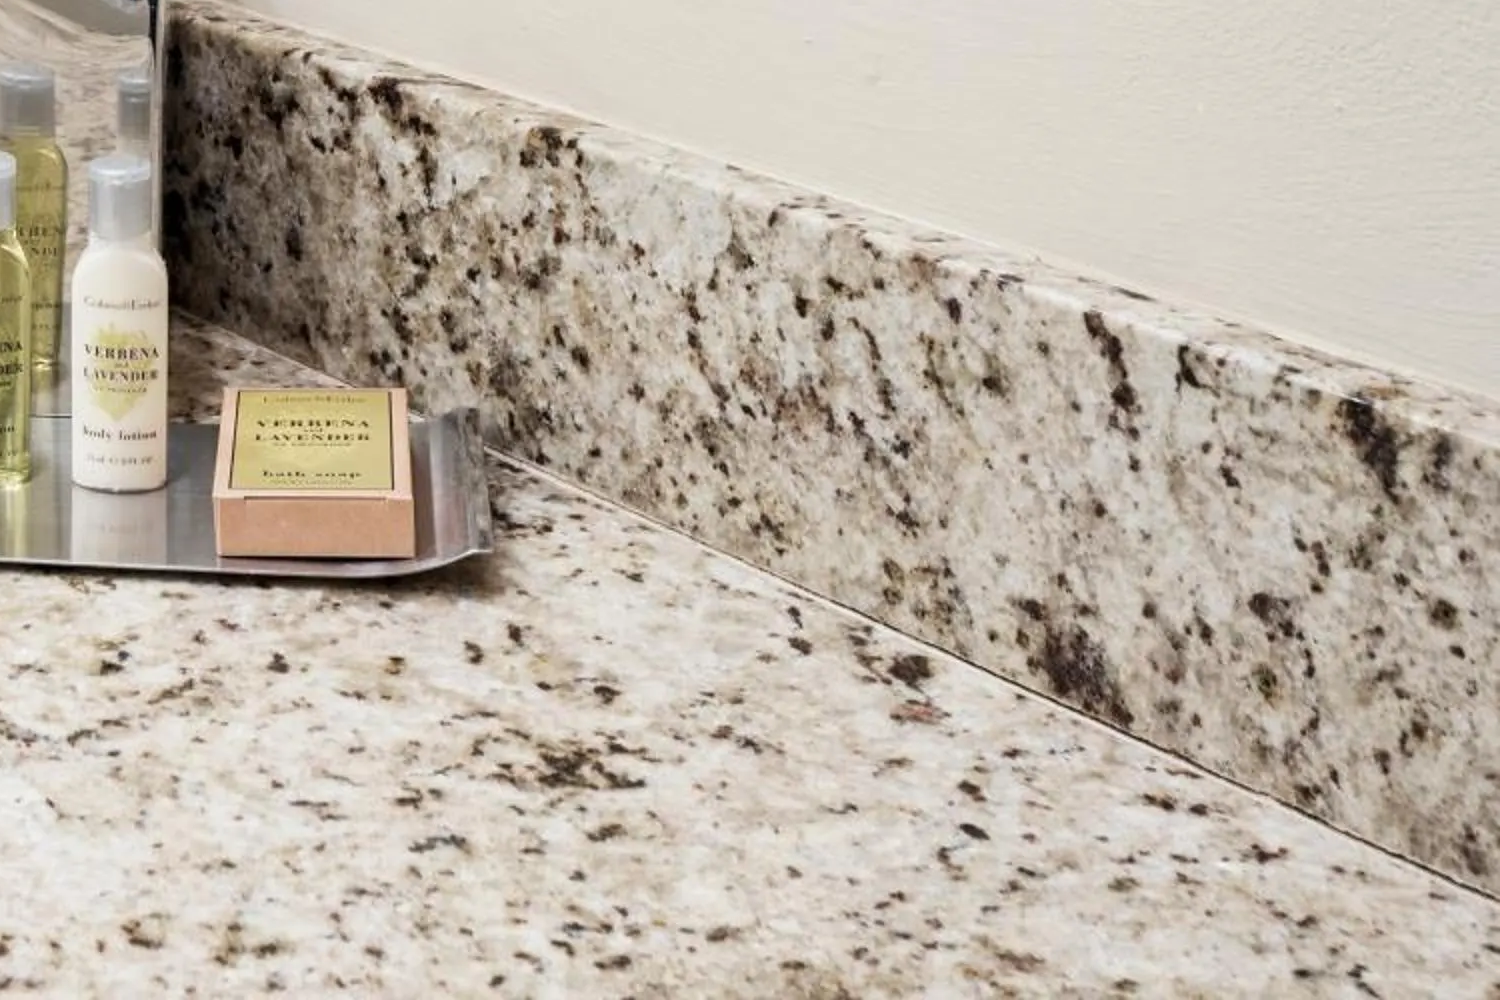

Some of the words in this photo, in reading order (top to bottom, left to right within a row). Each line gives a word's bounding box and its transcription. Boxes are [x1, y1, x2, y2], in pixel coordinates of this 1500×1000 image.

[83, 344, 160, 360] VERBENA
[83, 366, 159, 382] LAVENDER
[256, 419, 369, 428] VERBENA
[83, 424, 111, 442] body
[119, 429, 157, 441] lotion
